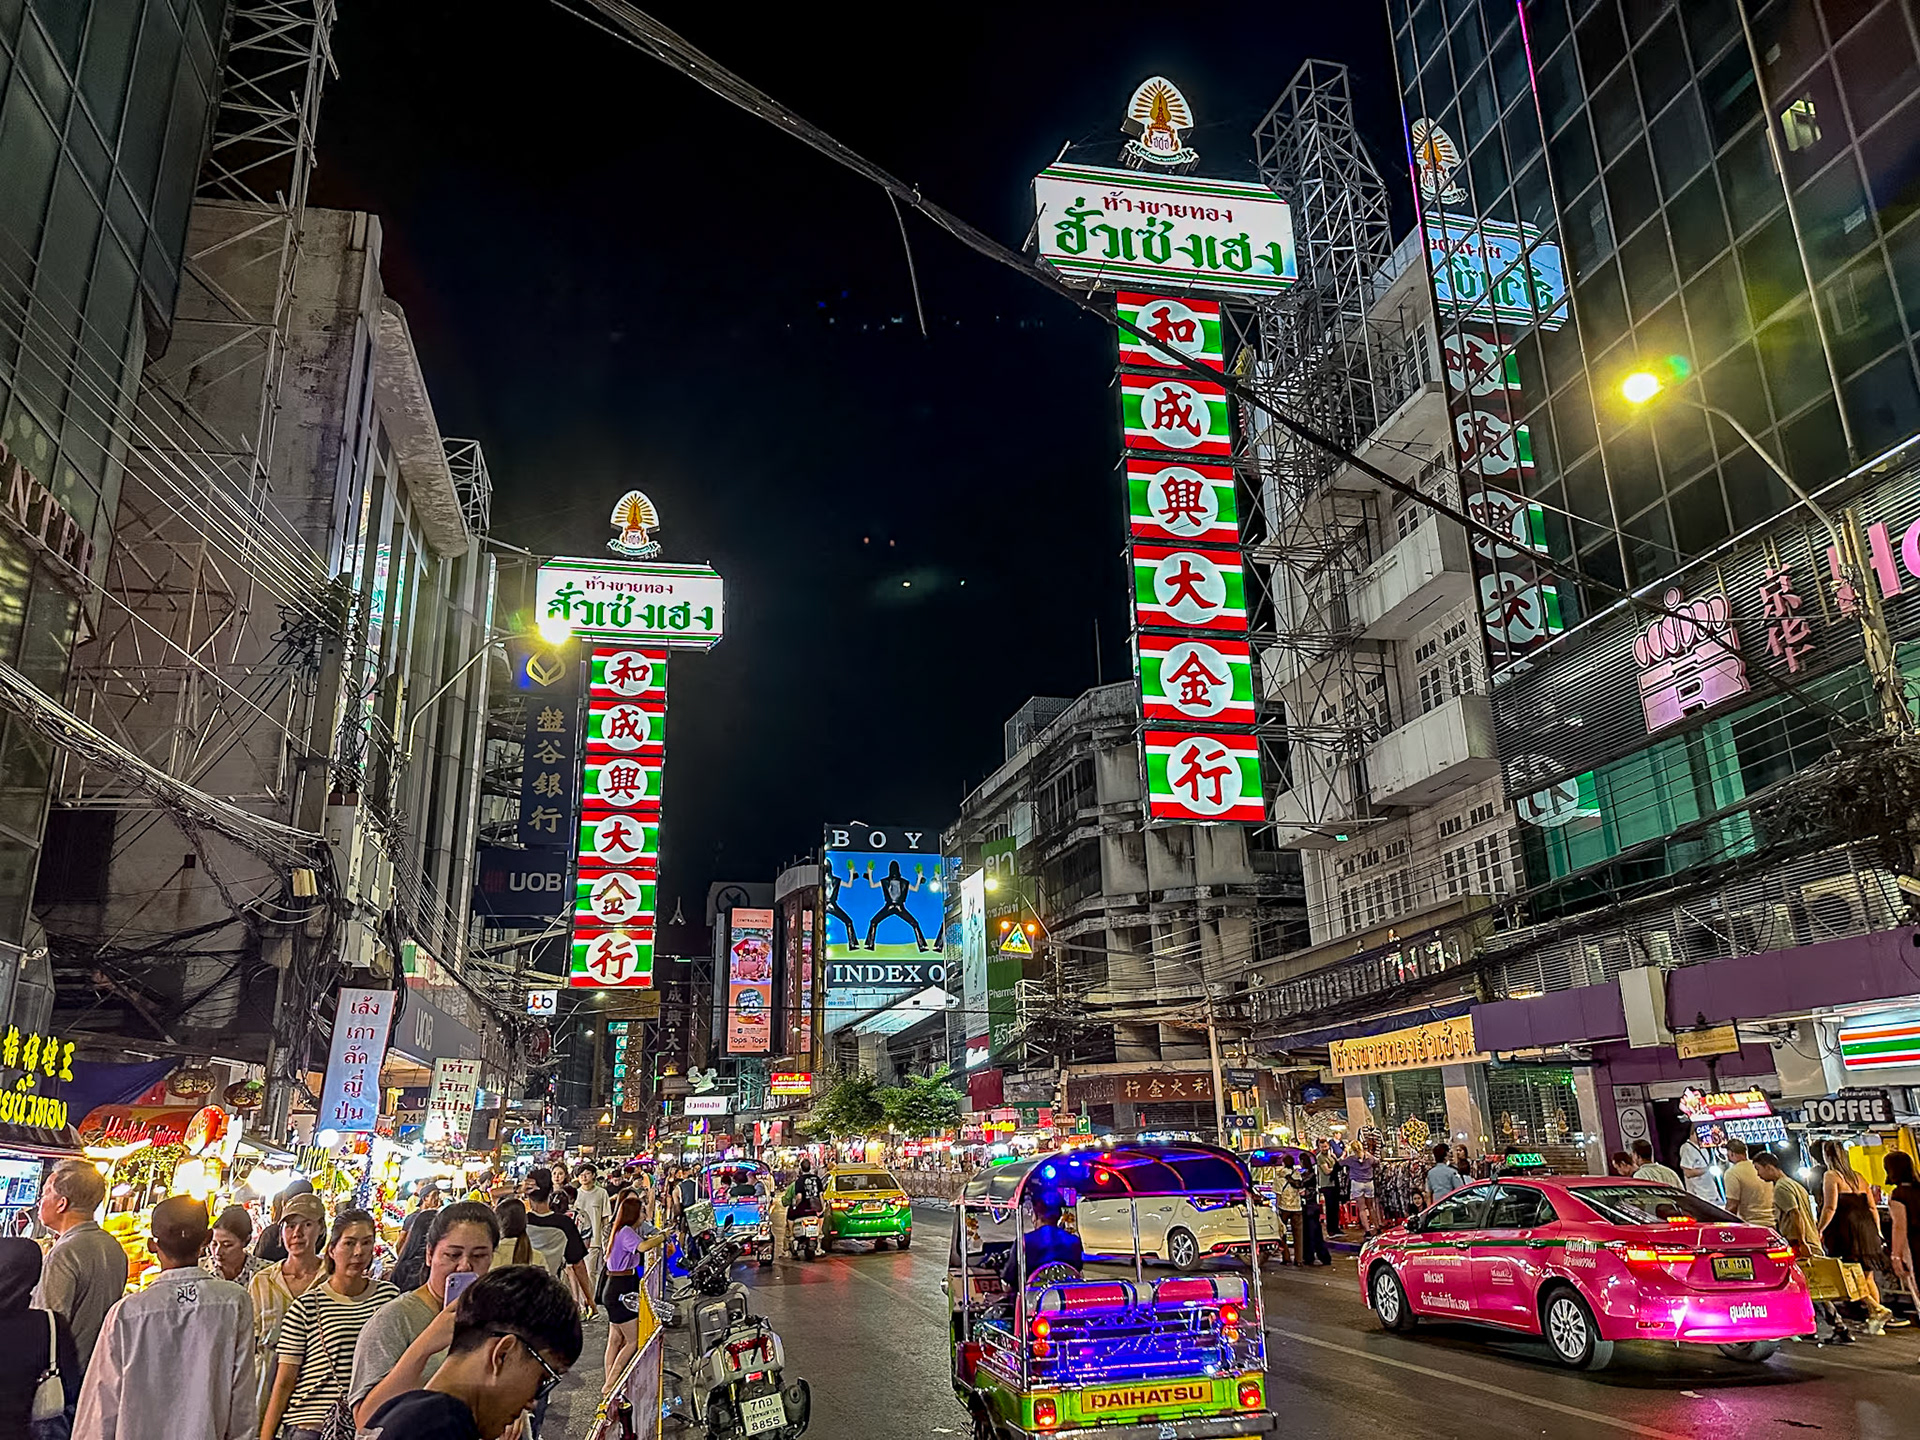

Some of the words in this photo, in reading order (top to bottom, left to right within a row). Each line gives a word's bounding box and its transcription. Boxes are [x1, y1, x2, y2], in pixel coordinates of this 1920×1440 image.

[1102, 191, 1233, 223] ห้างขายทอง
[1054, 196, 1284, 276] ฮั่วเซ่งเฮง
[1147, 305, 1233, 807] 和成興大金行
[586, 575, 673, 595] ห้างขายทอง
[527, 705, 566, 835] 盤谷銀行
[590, 656, 650, 980] 和成興大金行
[509, 871, 562, 893] UOB
[832, 965, 923, 983] INDEX
[346, 1025, 375, 1041] เกา
[414, 1008, 434, 1051] UOB
[1803, 1099, 1886, 1122] TOFFEE
[1091, 1384, 1204, 1409] DAIHATSU
[751, 1415, 780, 1431] 8855
